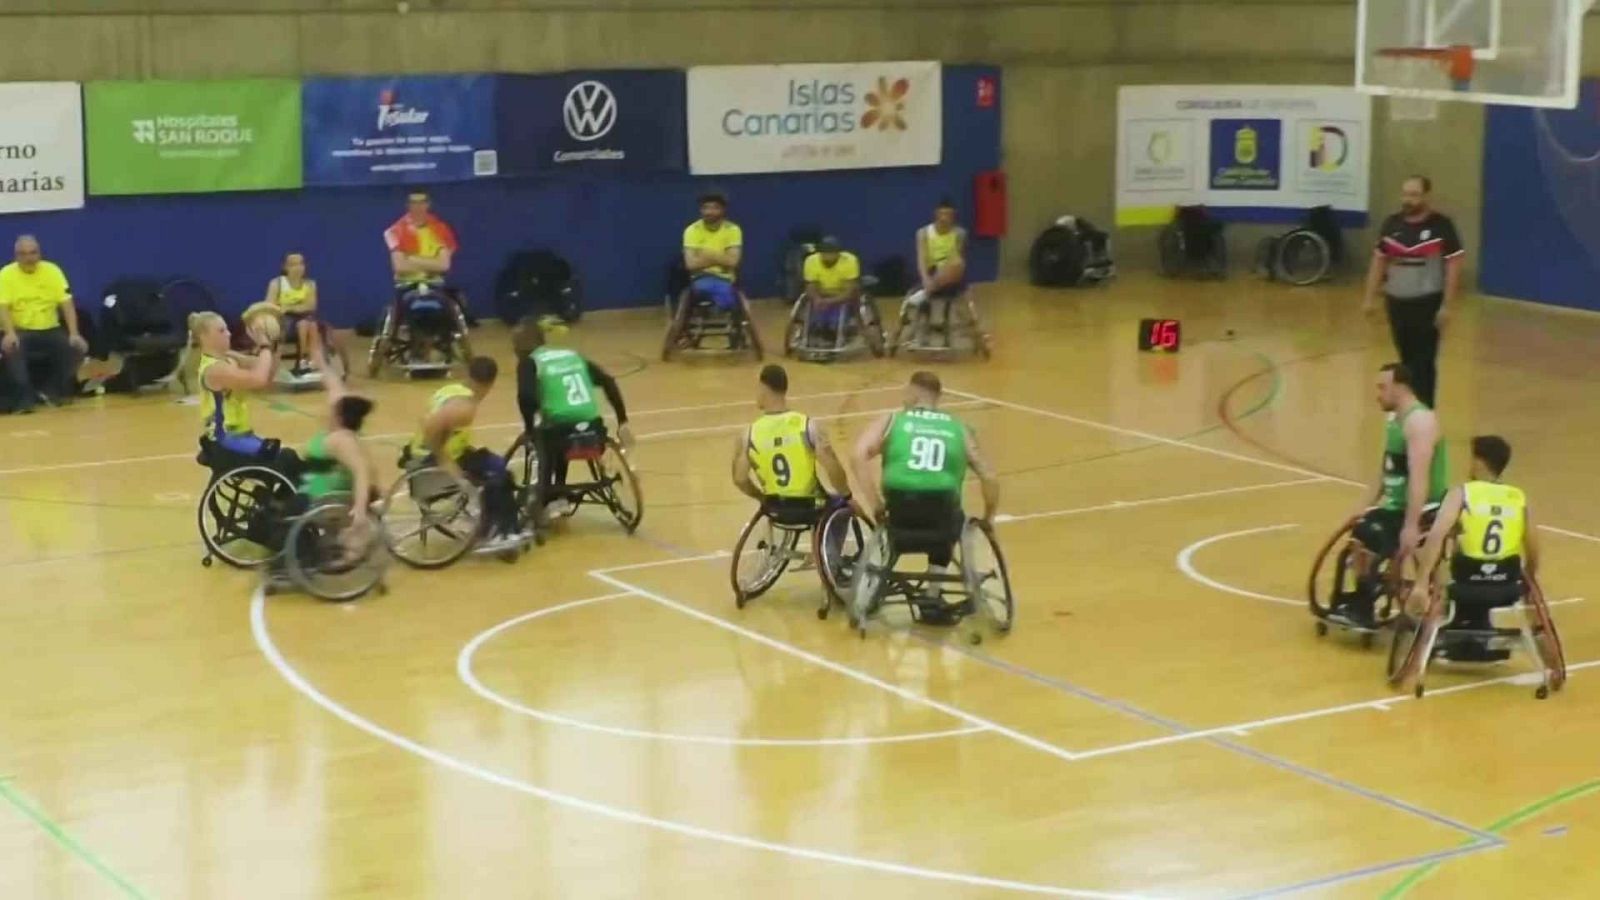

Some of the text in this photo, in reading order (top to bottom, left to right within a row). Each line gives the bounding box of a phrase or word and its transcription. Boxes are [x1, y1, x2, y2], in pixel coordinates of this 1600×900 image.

[788, 79, 856, 107] Islas
[158, 126, 254, 144] SAN ROQUE
[722, 107, 856, 137] Canarias
[1150, 319, 1177, 348] 16
[562, 372, 591, 406] 21
[907, 435, 946, 472] 90
[771, 453, 792, 487] 9
[1481, 519, 1504, 555] 6
